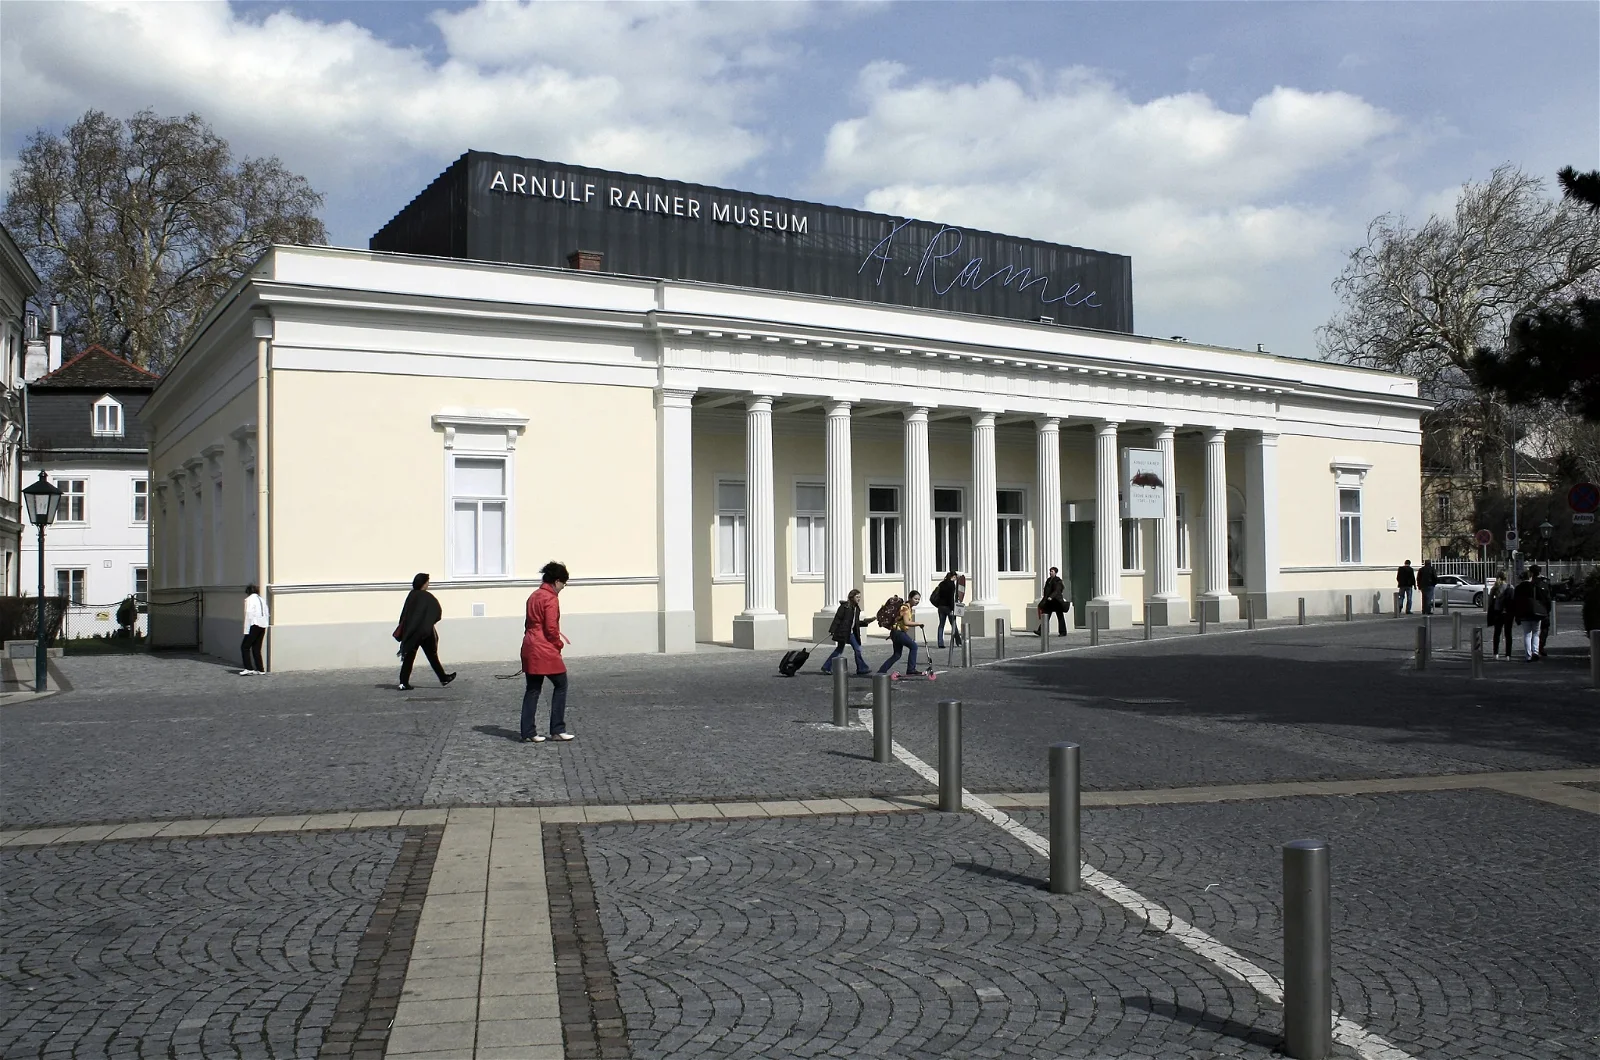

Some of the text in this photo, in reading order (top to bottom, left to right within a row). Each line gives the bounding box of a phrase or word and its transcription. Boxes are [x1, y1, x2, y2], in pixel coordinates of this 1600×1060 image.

[489, 170, 809, 234] ARNULF RAINER MUSEUM
